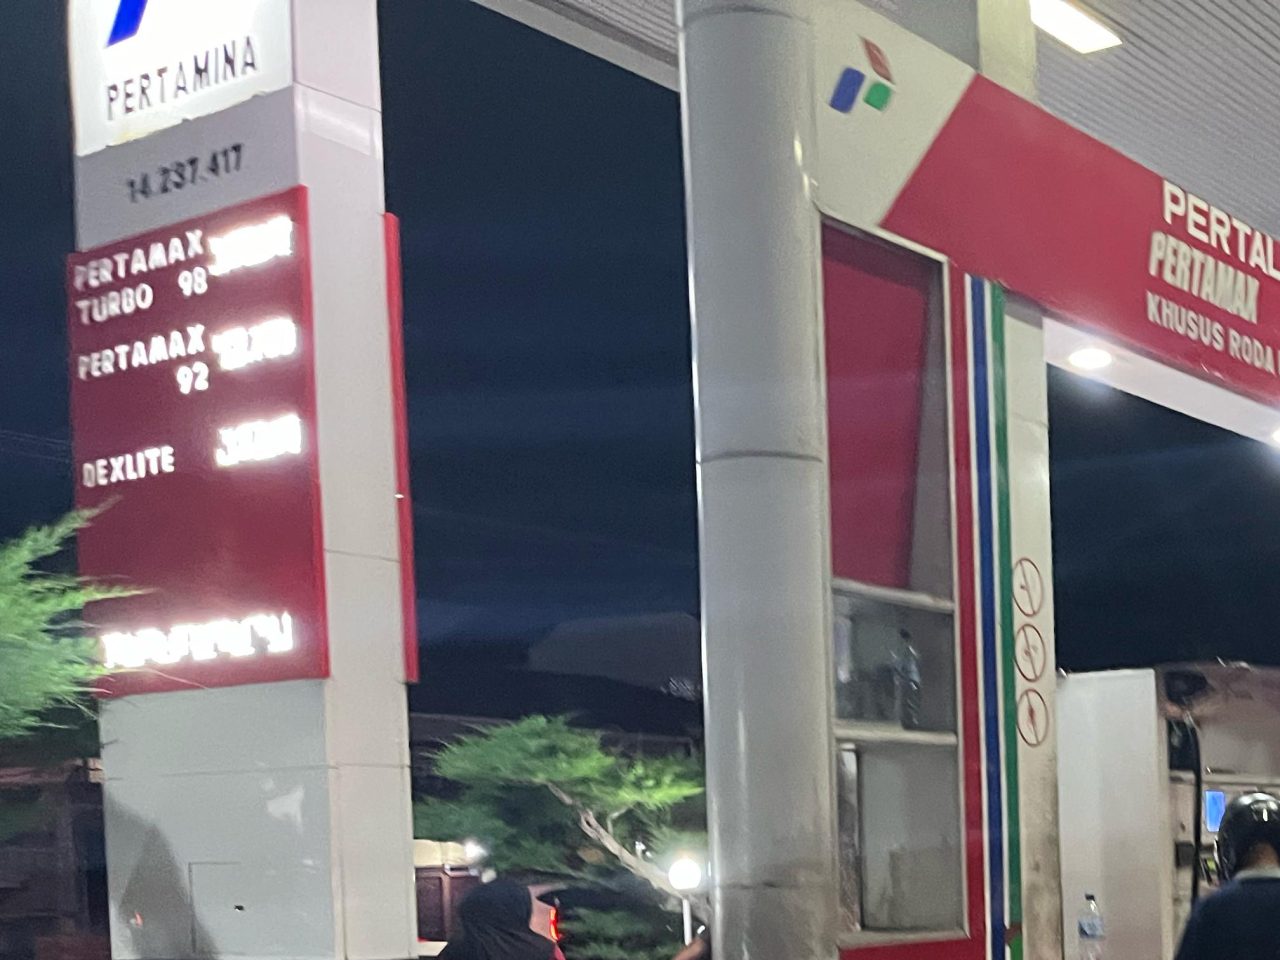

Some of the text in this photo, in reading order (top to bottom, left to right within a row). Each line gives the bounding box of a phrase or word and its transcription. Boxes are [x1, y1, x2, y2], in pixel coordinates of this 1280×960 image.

[106, 35, 258, 121] PERTAMINA
[74, 229, 204, 292] PERTAMAX
[76, 266, 208, 325] TURBO 98
[77, 324, 205, 381] PERTAMAX
[1146, 290, 1225, 352] KHUSUS
[1228, 327, 1276, 376] RODA
[176, 362, 209, 394] 92
[82, 445, 175, 488] DEXLITE
